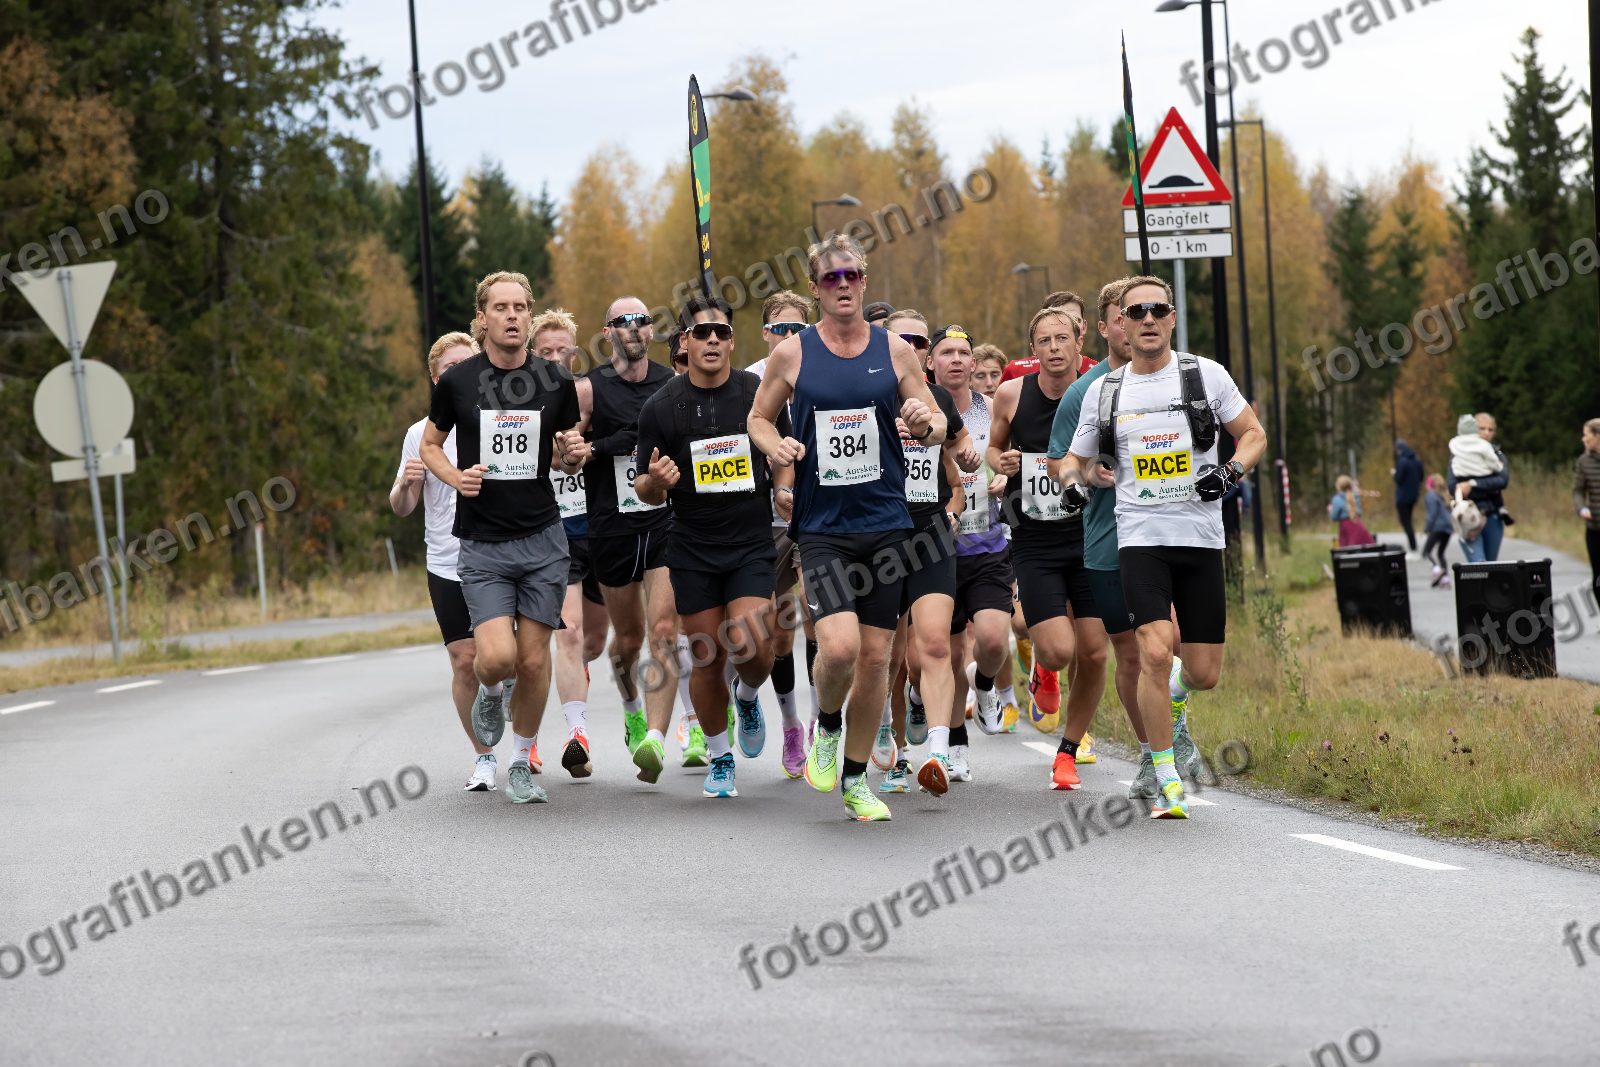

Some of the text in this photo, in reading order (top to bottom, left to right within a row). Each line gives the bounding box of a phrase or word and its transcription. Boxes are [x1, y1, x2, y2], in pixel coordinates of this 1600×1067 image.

[1146, 211, 1210, 228] Gangfelt
[1151, 242, 1160, 254] 0
[1176, 241, 1181, 253] 1
[1186, 241, 1207, 253] km
[830, 413, 868, 423] NORGES
[497, 421, 525, 429] LØPET
[834, 421, 863, 430] LØPET
[1141, 432, 1180, 442] NORGES
[492, 433, 528, 454] 818
[704, 439, 739, 450] NORGES
[829, 433, 868, 458] 384
[1145, 441, 1174, 450] LØPET
[708, 446, 734, 456] LØPET
[505, 462, 536, 472] Aurskog
[699, 458, 748, 481] PACE
[845, 464, 878, 475] Aurskog
[1136, 453, 1188, 477] PACE
[908, 489, 937, 499] Aurskog
[1159, 483, 1194, 495] Aurskog
